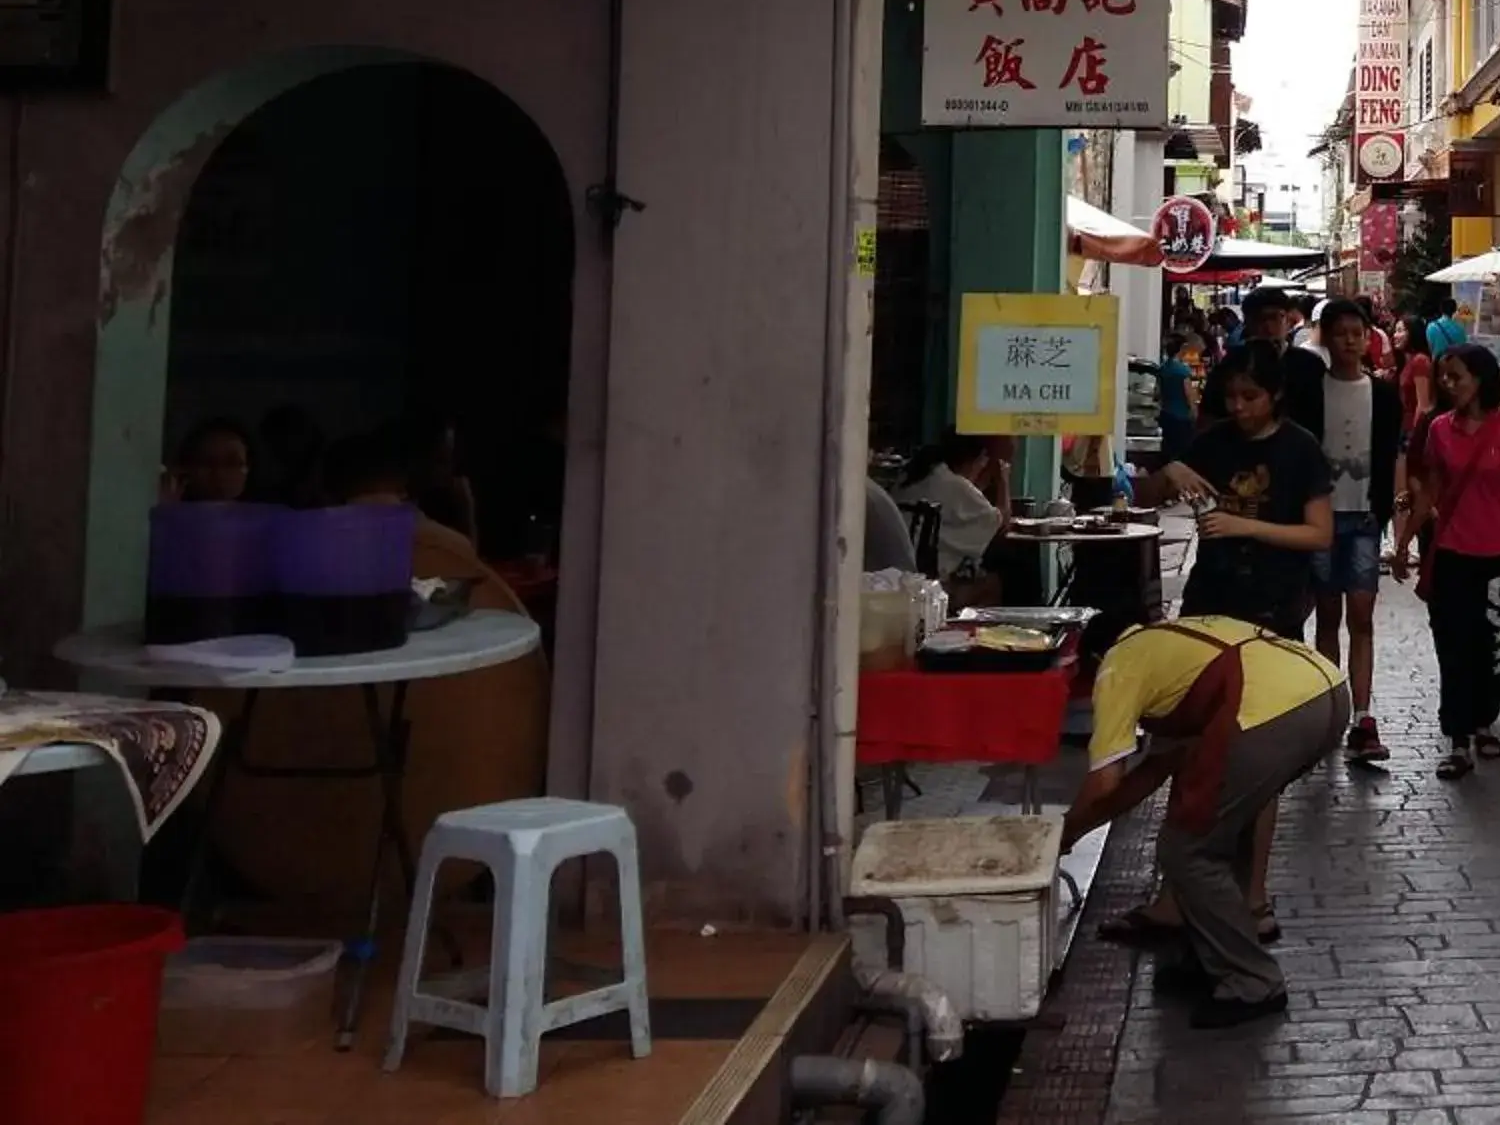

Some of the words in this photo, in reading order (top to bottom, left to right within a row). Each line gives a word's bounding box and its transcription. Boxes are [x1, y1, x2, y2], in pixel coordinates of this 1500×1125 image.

[975, 34, 1112, 95] 飯店
[1359, 65, 1401, 92] DING
[1359, 98, 1401, 124] FENG
[1003, 384, 1032, 401] MA
[1039, 384, 1072, 401] CHI
